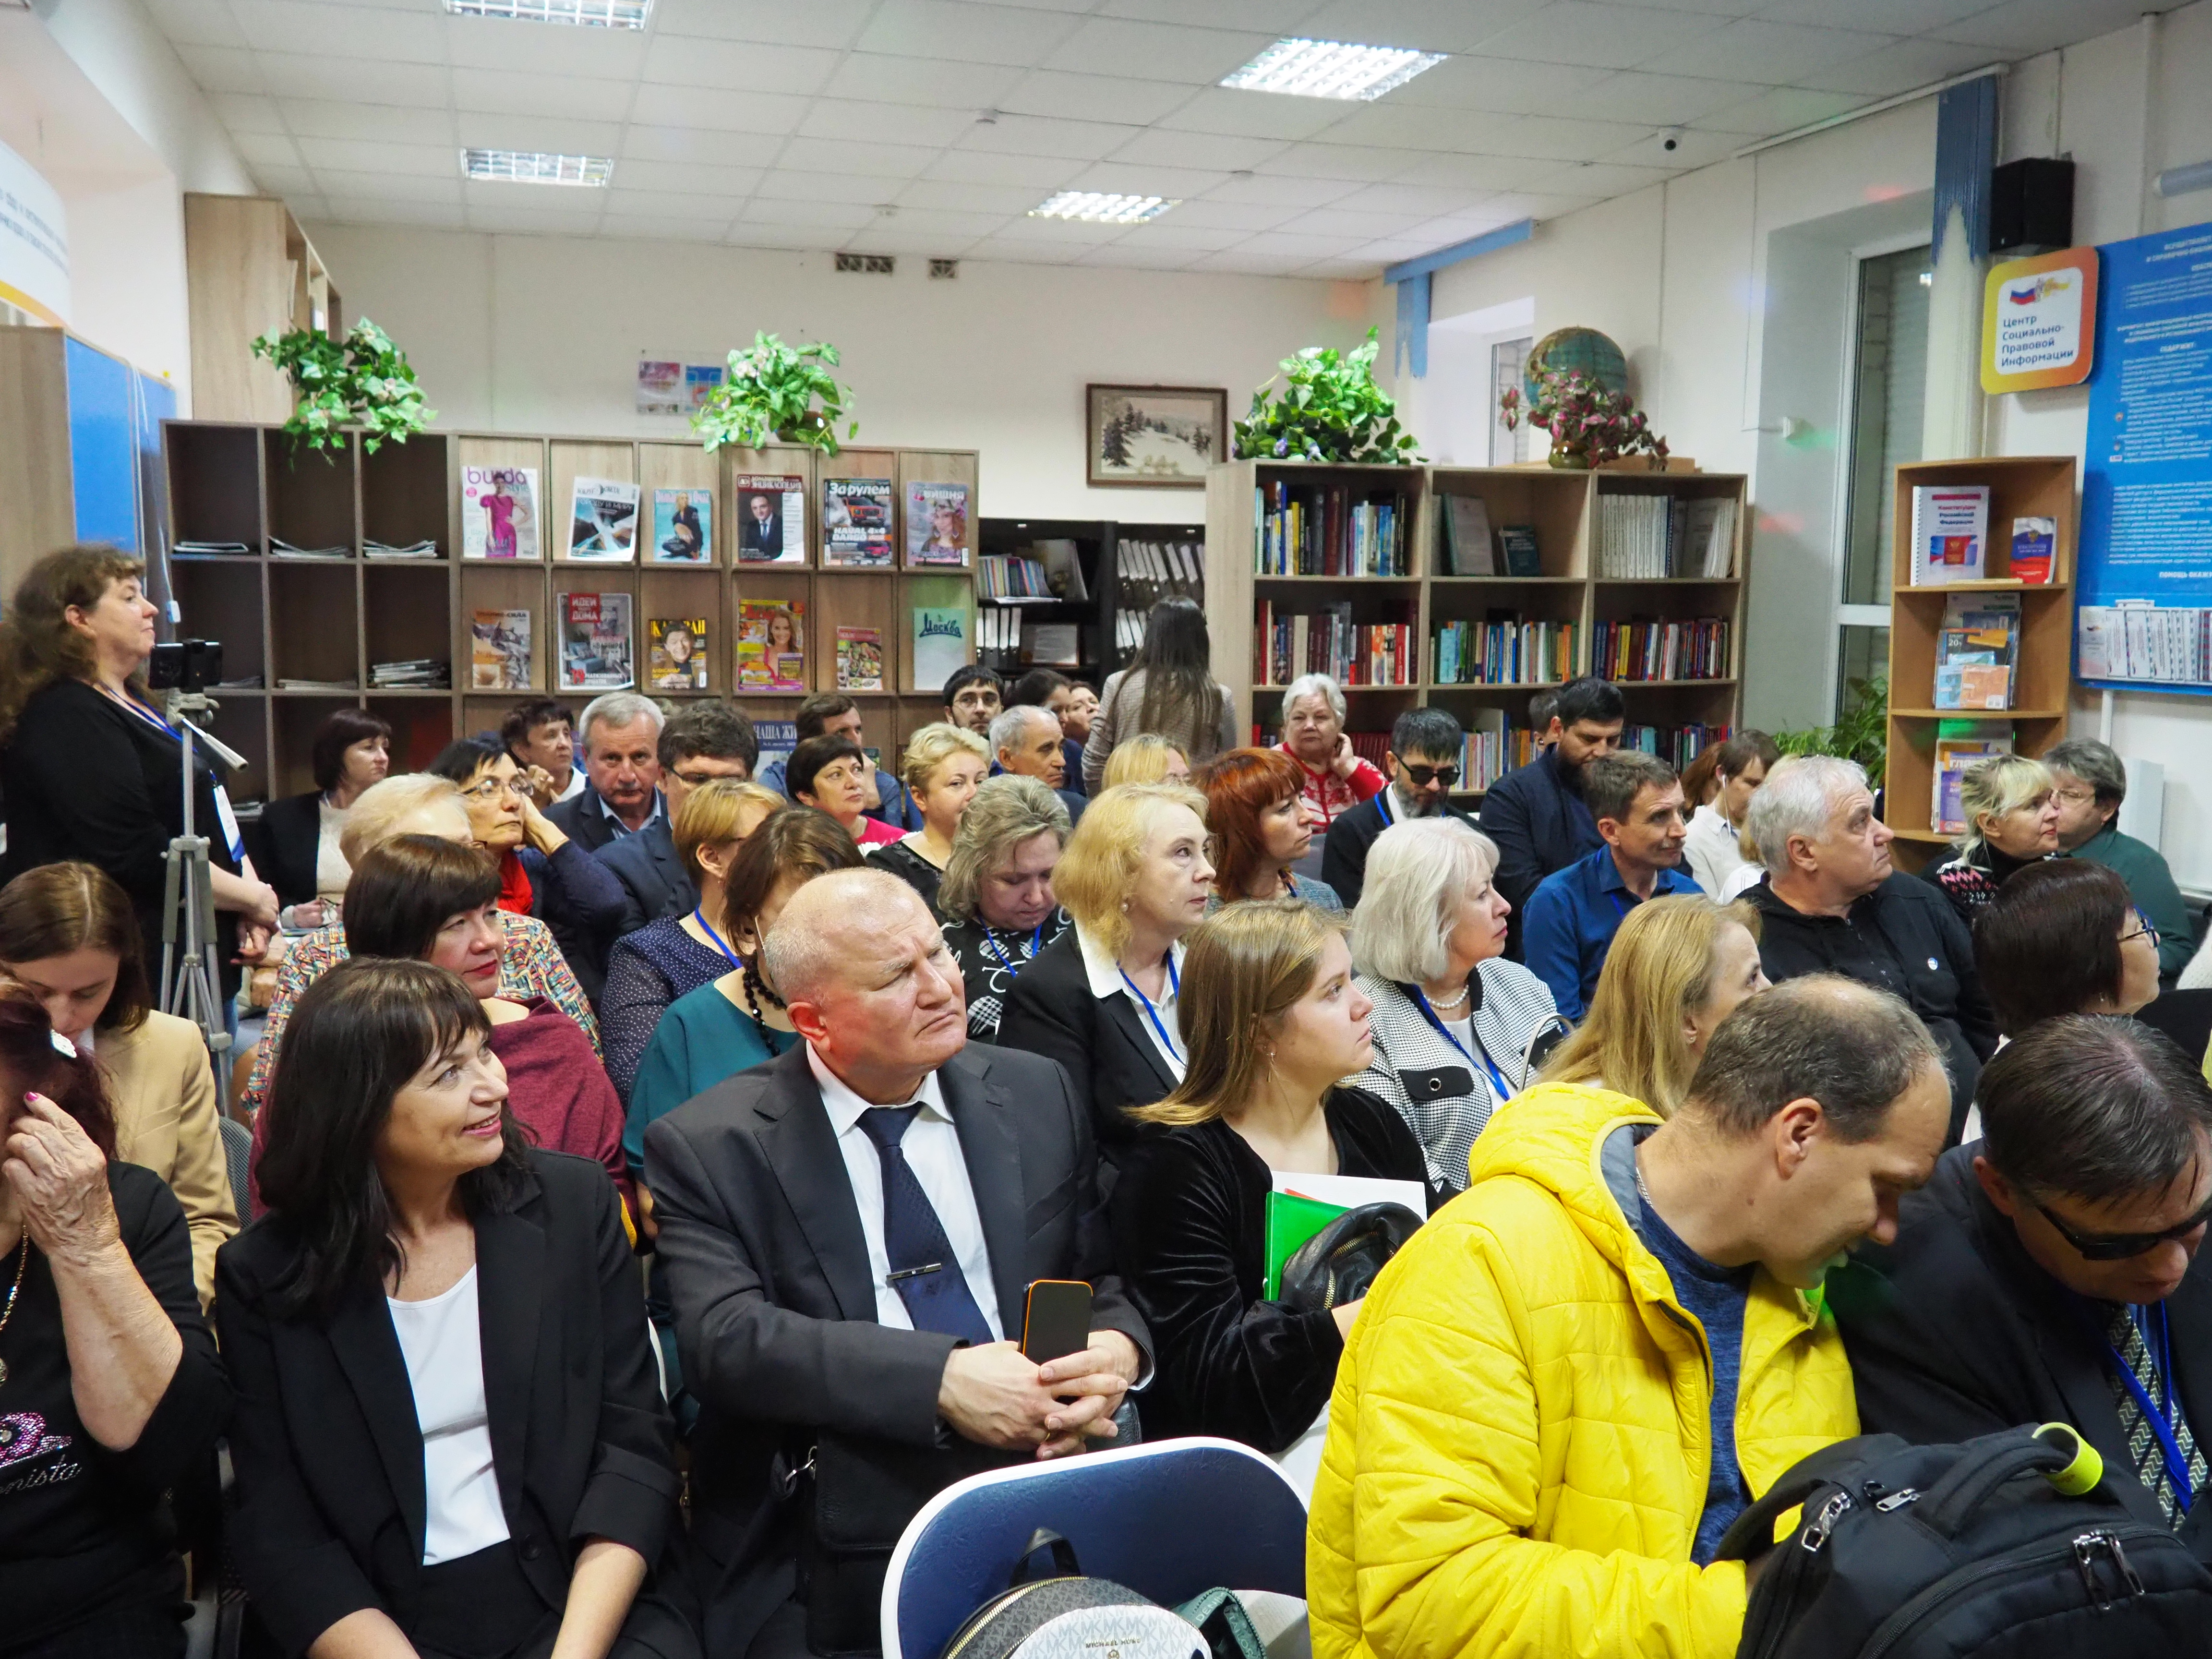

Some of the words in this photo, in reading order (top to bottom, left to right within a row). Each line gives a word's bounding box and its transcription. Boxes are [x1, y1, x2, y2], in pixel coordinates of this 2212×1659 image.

[2004, 316, 2037, 328] Центр
[2003, 325, 2064, 340] Социально-
[2002, 337, 2055, 355] Правовой
[2001, 349, 2074, 367] Информации
[829, 482, 847, 494] За
[572, 598, 597, 606] ИДЕИ
[572, 611, 598, 620] ДОМА
[782, 724, 797, 739] ЖИ
[0, 1454, 83, 1494] nista
[1196, 1592, 1226, 1623] DENIM
[1085, 1638, 1118, 1648] MICHAEL
[1120, 1636, 1142, 1645] KORS
